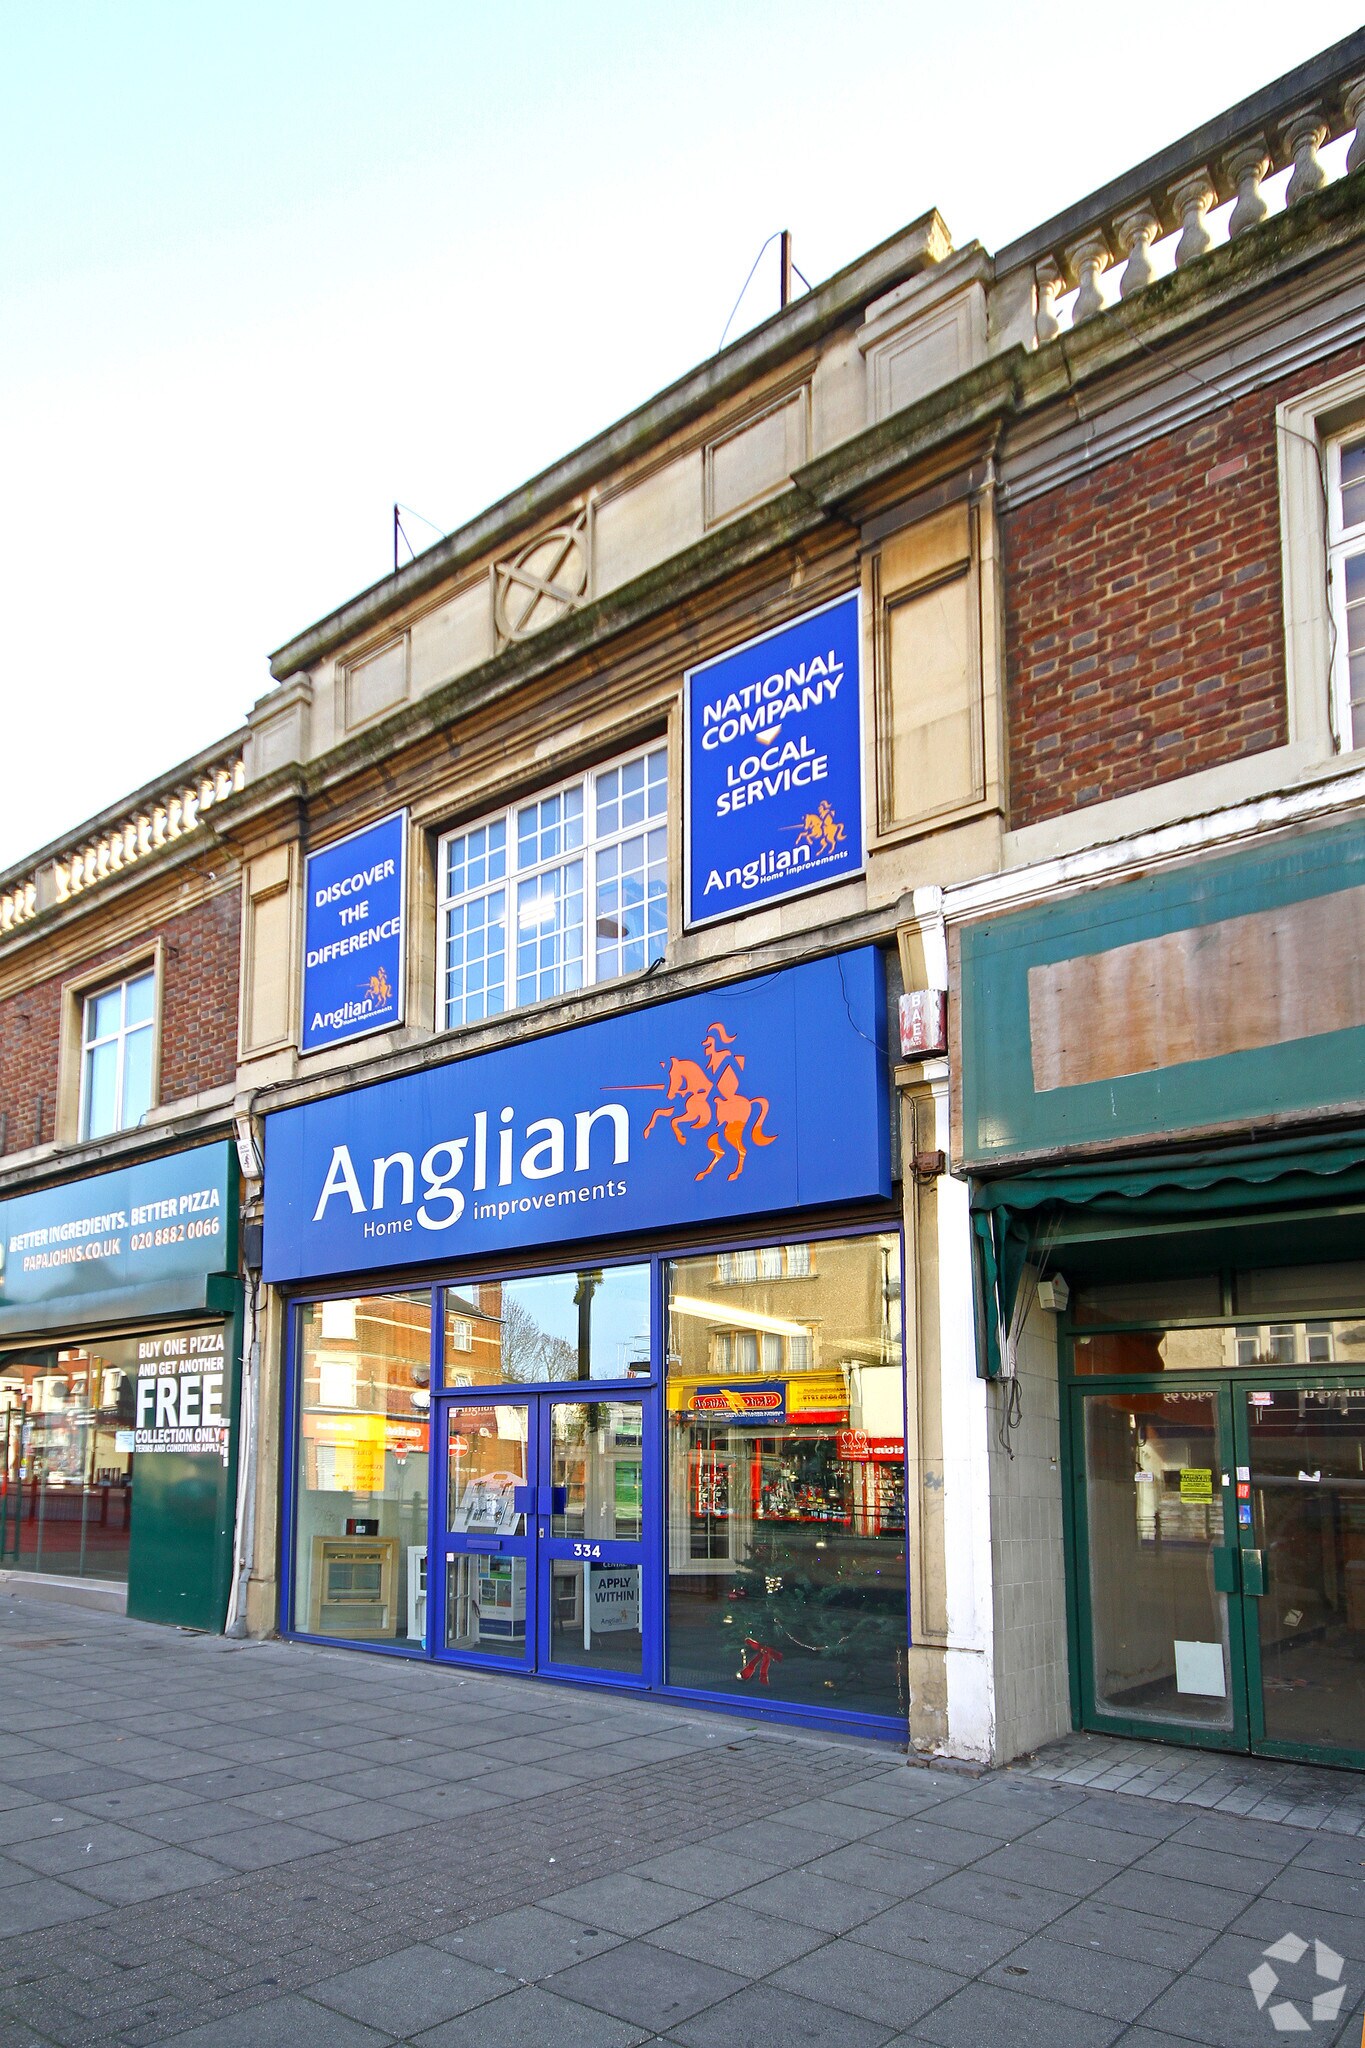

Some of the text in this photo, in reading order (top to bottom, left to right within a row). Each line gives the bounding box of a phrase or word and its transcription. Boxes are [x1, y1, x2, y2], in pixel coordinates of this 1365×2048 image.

[701, 672, 844, 751] COMPANY
[703, 649, 844, 728] NATIONAL
[716, 755, 828, 817] SERVICE
[727, 736, 815, 788] LOCAL
[315, 859, 395, 907] DISCOVER
[703, 844, 811, 896] Anglian
[760, 850, 848, 884] Home improvements
[339, 900, 369, 926] THE
[306, 916, 401, 968] DIFFERENCE
[310, 998, 372, 1031] Anglian
[311, 1103, 631, 1231] Anglian
[9, 1188, 220, 1252] BETTER INGREDIENTS. BETTER PIZZA
[363, 1179, 628, 1238] Home improvements
[23, 1217, 220, 1272] PAPAJOHNS.CO.UK 020 8882 0066
[138, 1356, 224, 1377] AND GET ANOTHER
[139, 1334, 225, 1359] BUY ONE PIZZA
[136, 1373, 224, 1428] FREE
[135, 1428, 192, 1444] COLLECTION
[194, 1427, 221, 1443] ONLY
[135, 1443, 220, 1453] TERMS AND CONDITIONS APPLY
[573, 1543, 602, 1558] 334
[595, 1590, 634, 1603] WITHIN
[598, 1577, 631, 1589] APPLY
